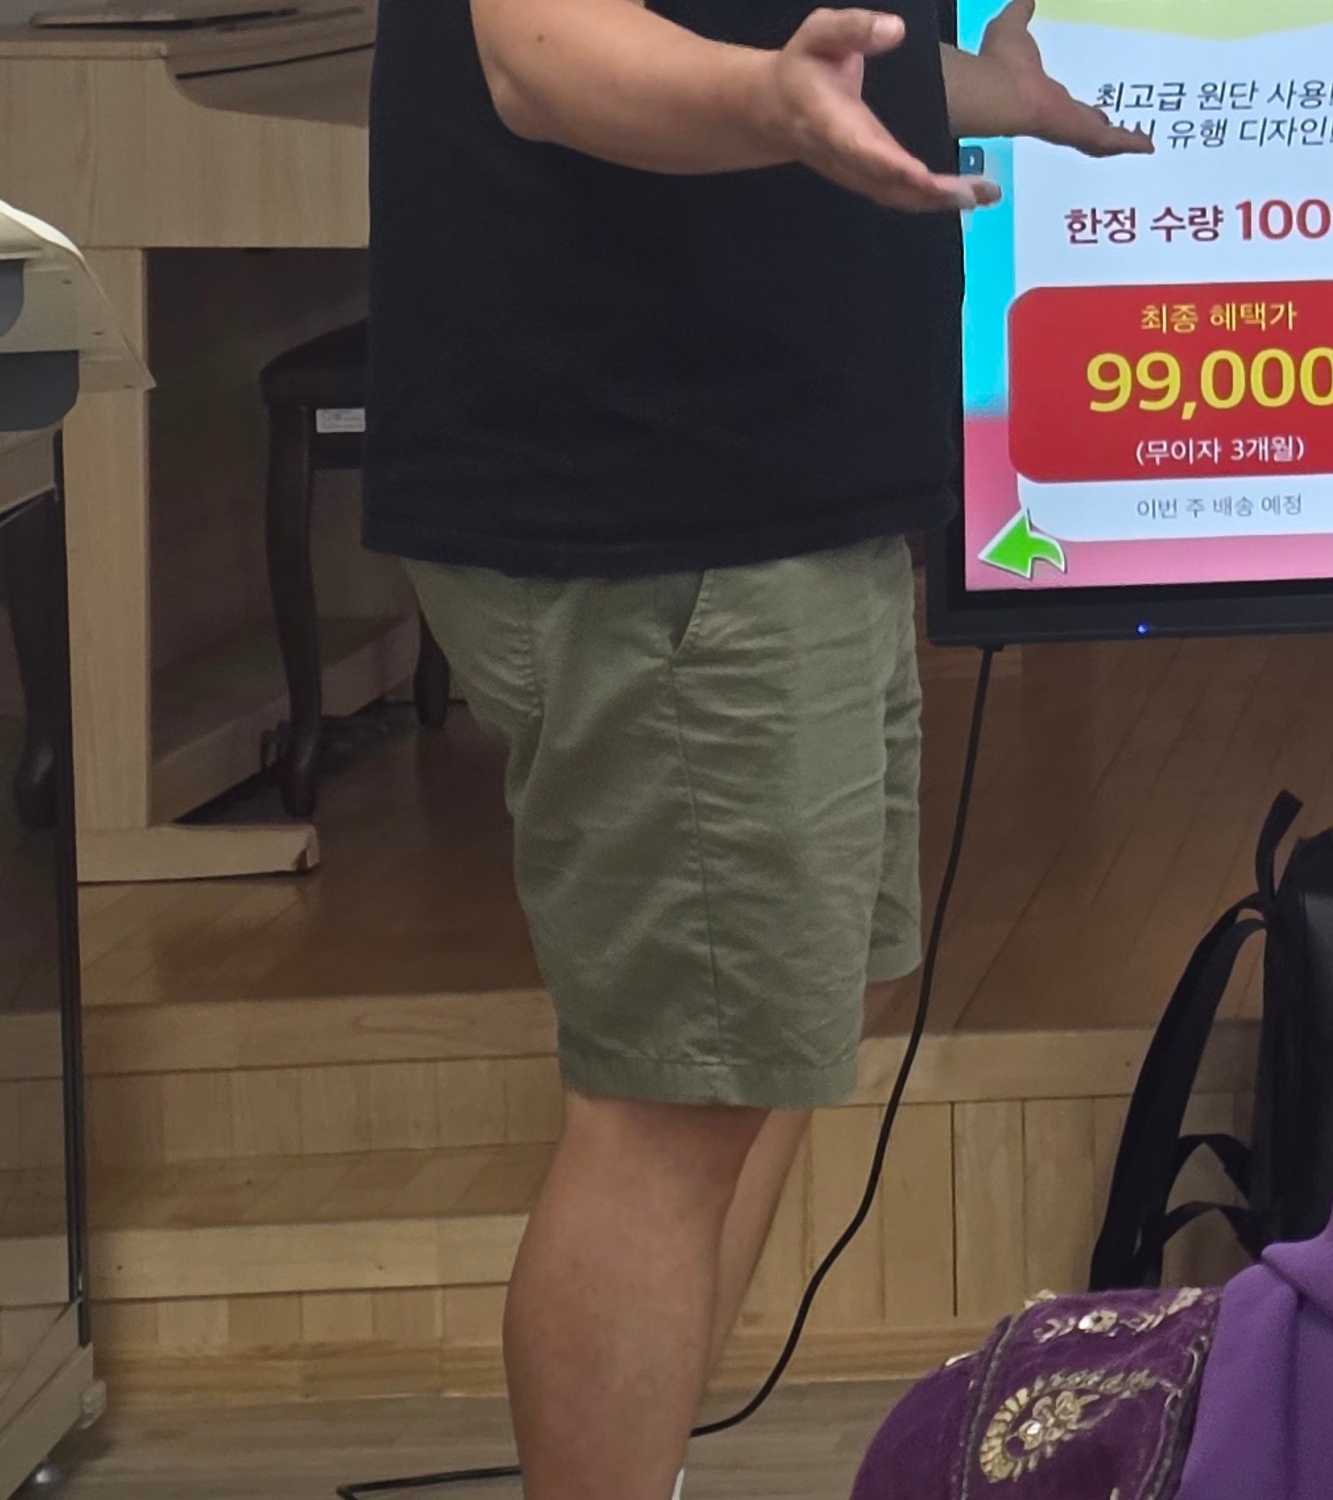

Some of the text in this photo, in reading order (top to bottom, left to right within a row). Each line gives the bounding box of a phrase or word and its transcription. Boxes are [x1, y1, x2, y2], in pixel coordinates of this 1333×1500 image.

[1096, 81, 1187, 112] 최고급
[1197, 80, 1259, 111] 원단
[1166, 117, 1228, 150] 유행
[1064, 206, 1138, 245] 한정
[1149, 204, 1224, 243] 수량
[1140, 301, 1298, 334] 최종 혜택가
[1136, 435, 1305, 466] (무이자 3개월)
[1137, 493, 1302, 520] 이번 주 배송 예정
